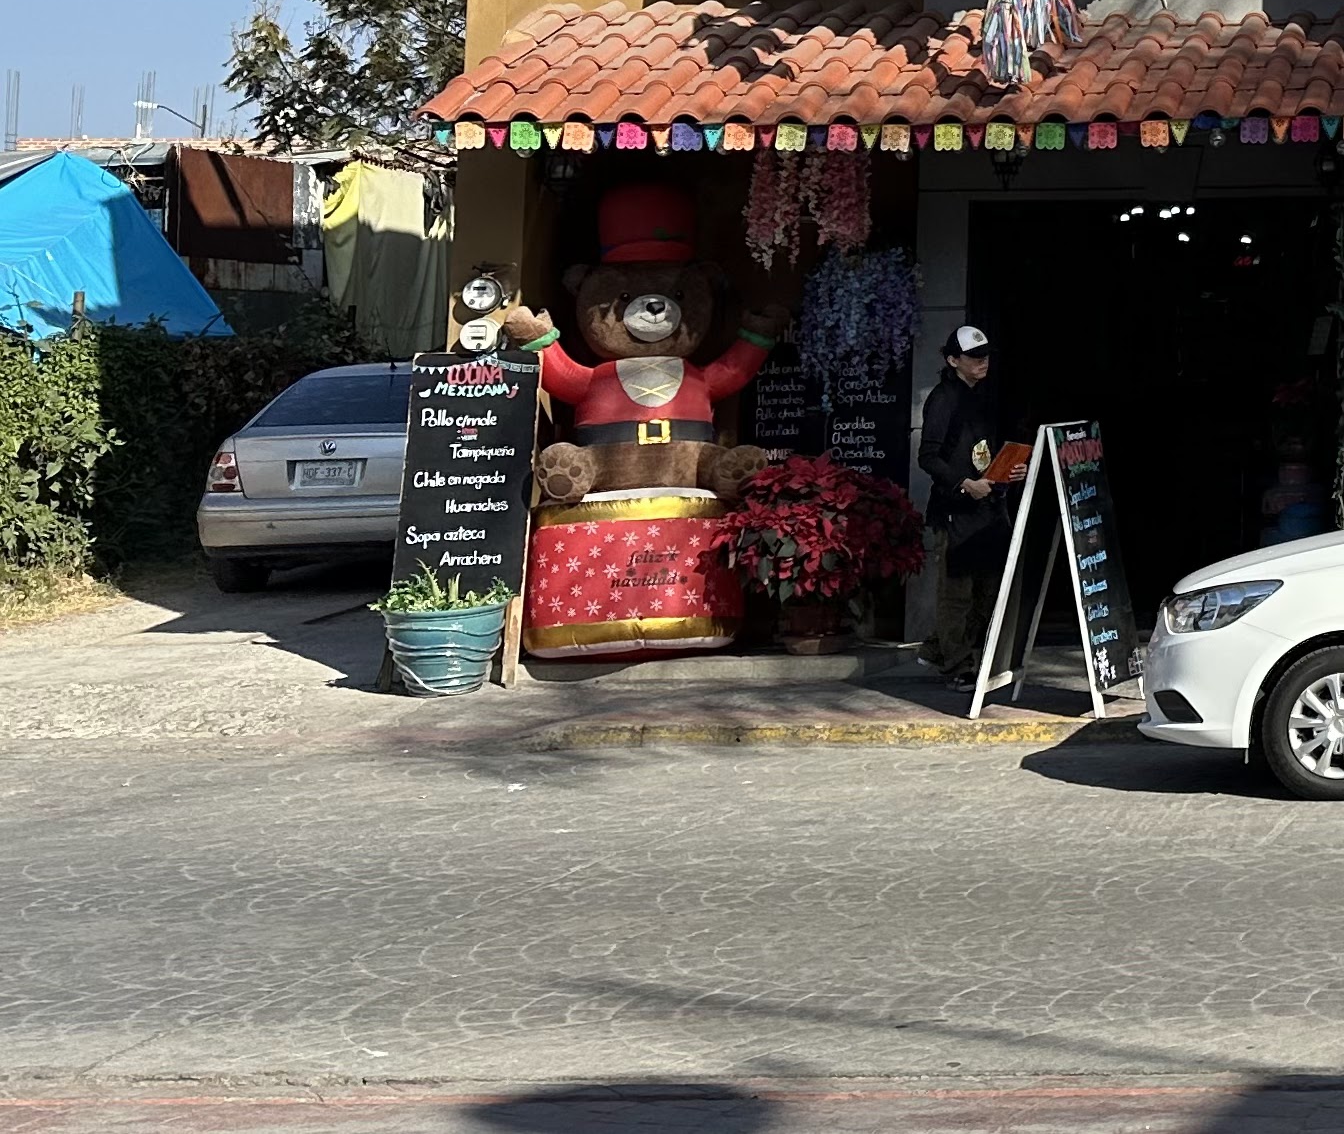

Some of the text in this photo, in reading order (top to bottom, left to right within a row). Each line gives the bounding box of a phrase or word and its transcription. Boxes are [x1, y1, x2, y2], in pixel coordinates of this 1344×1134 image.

[446, 365, 504, 385] COCINA
[434, 382, 510, 398] MEXICANA
[421, 408, 454, 427] Pollo
[413, 471, 506, 490] Chile en nogada
[445, 498, 509, 514] Huaraches
[405, 526, 486, 550] Sopa azteca
[439, 551, 502, 567] Arrachera
